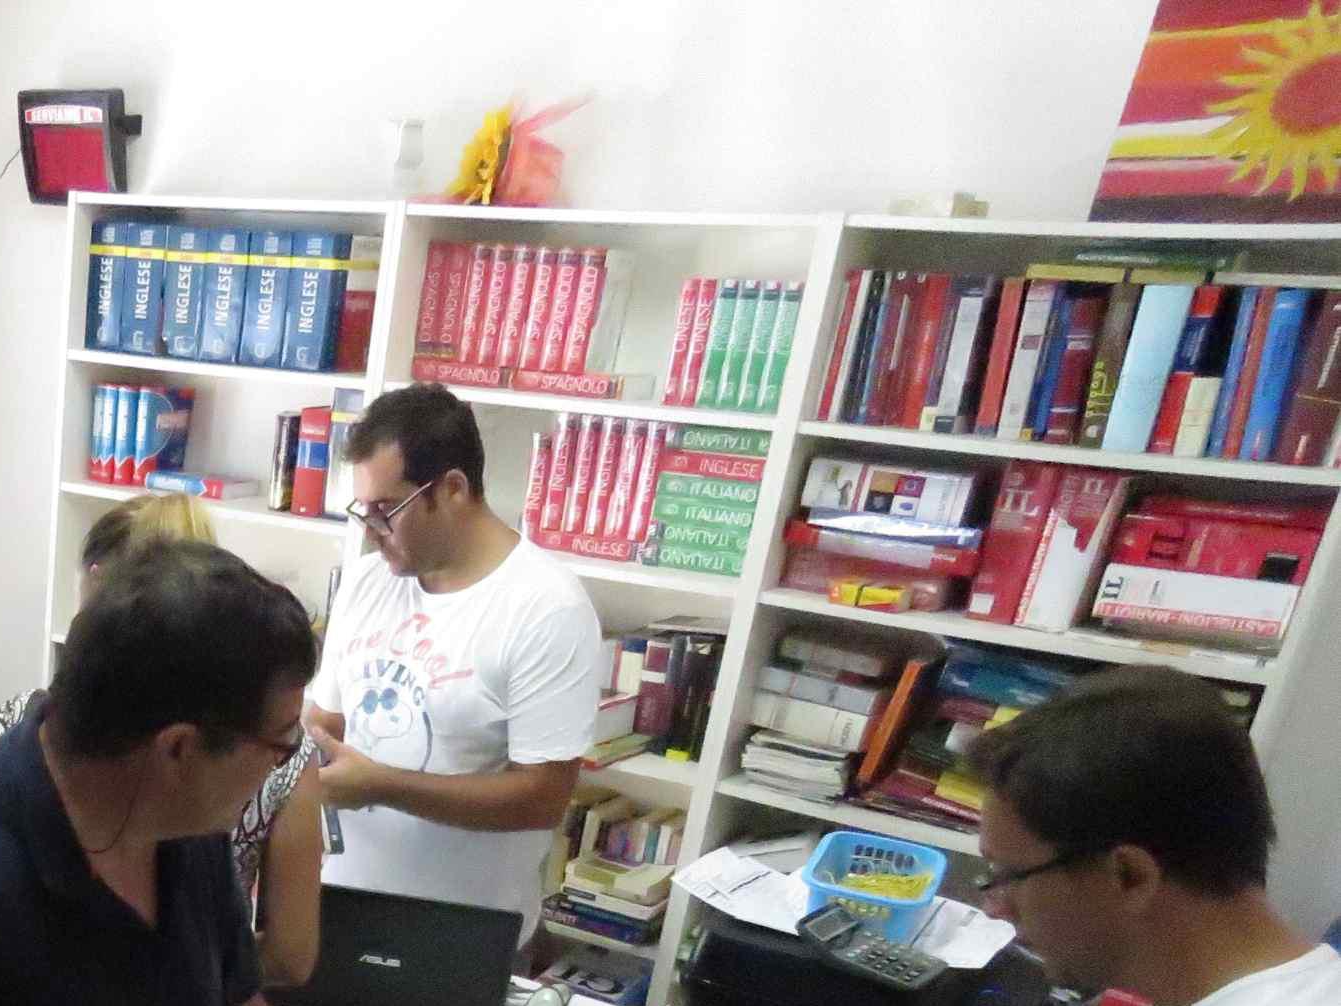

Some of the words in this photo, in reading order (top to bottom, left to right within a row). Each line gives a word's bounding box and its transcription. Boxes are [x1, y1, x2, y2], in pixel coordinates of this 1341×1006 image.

[97, 257, 113, 314] INGLESE
[134, 261, 151, 320] INGLESE
[176, 264, 193, 323] INGLESE
[214, 266, 233, 327] INGLESE
[256, 269, 276, 331] INGLESE
[298, 271, 319, 334] INGLESE
[486, 261, 506, 335] SPAGNOLO
[505, 263, 528, 337] SPAGNOLO
[549, 265, 573, 342] SPAGNOLO
[572, 266, 598, 343] SPAGNOLO
[437, 365, 499, 386] SPAGNOLO
[539, 373, 608, 395] SPAGNOLO
[684, 430, 752, 450] ITALIANO
[698, 458, 759, 479] INGLESE
[684, 505, 754, 527] ITALIANO
[688, 479, 758, 503] ITALIANO
[571, 538, 628, 558] INGLESE
[658, 548, 725, 569] ITALIANO
[663, 525, 732, 546] ITALIANO
